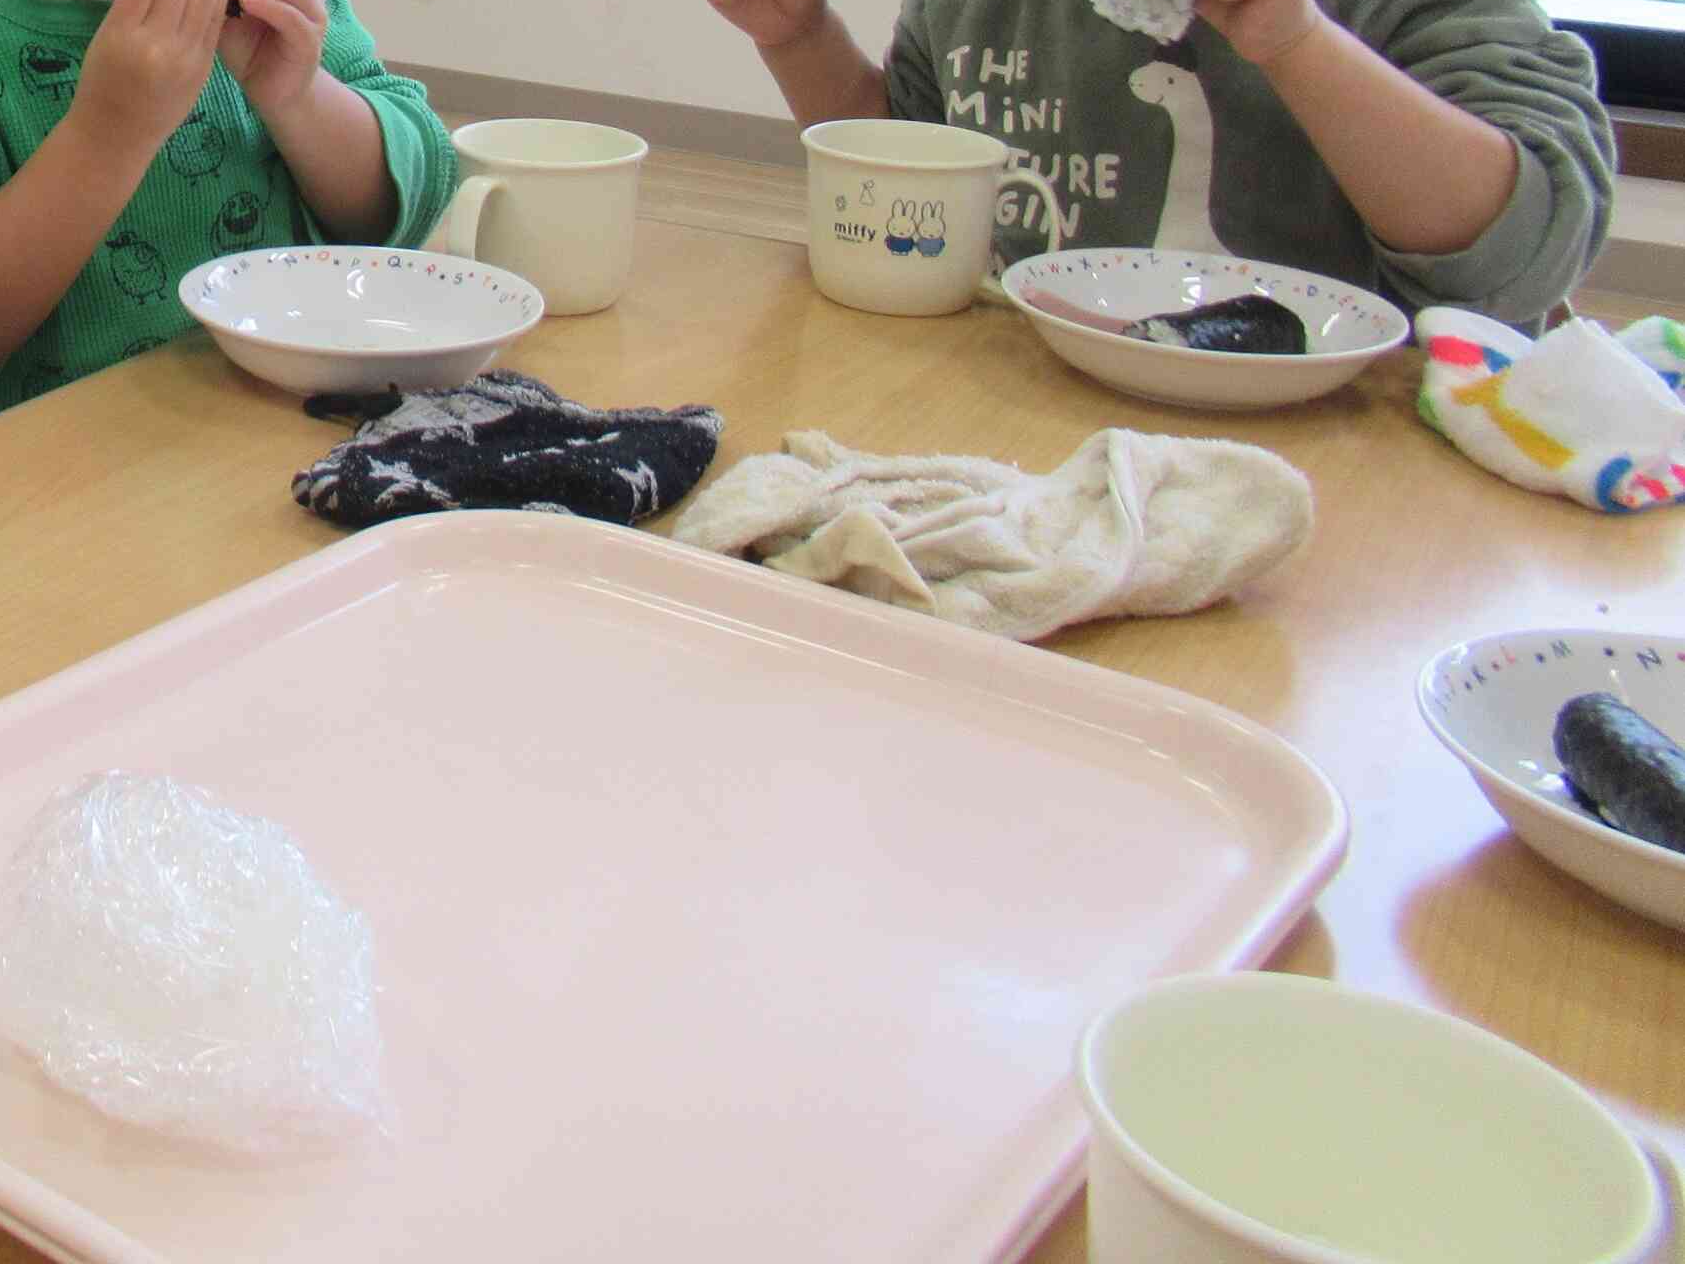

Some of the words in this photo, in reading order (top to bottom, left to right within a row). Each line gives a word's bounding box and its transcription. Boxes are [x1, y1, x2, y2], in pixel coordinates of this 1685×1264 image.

[947, 45, 1029, 85] THE
[834, 221, 876, 242] miffy
[387, 255, 402, 269] Q
[1078, 256, 1092, 271] X
[1550, 639, 1573, 660] M
[1635, 646, 1663, 671] N
